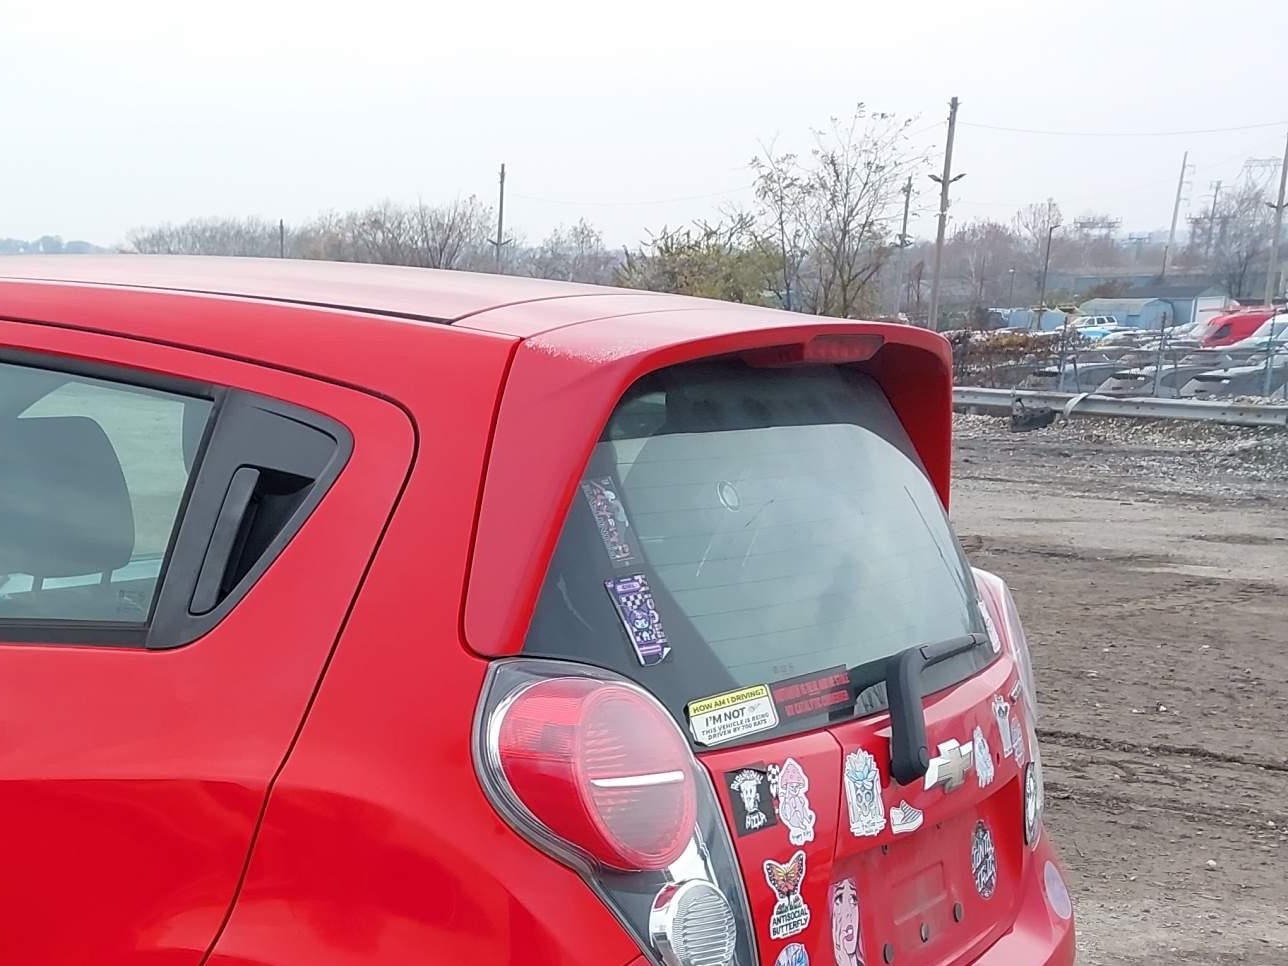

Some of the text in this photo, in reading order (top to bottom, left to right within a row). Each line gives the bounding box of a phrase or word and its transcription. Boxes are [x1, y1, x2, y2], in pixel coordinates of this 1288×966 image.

[693, 701, 713, 714] HOW
[714, 698, 726, 710] AM
[731, 688, 765, 704] DRIVING?
[701, 726, 717, 736] THIS
[719, 719, 744, 732] VEHICLE
[752, 712, 770, 722] BEING
[705, 707, 747, 727] I'M NOT
[708, 730, 732, 741] DRIVEN
[733, 726, 742, 734] BY
[772, 907, 809, 925] ANTISOCIAL
[772, 917, 809, 936] BUTTERFLY
